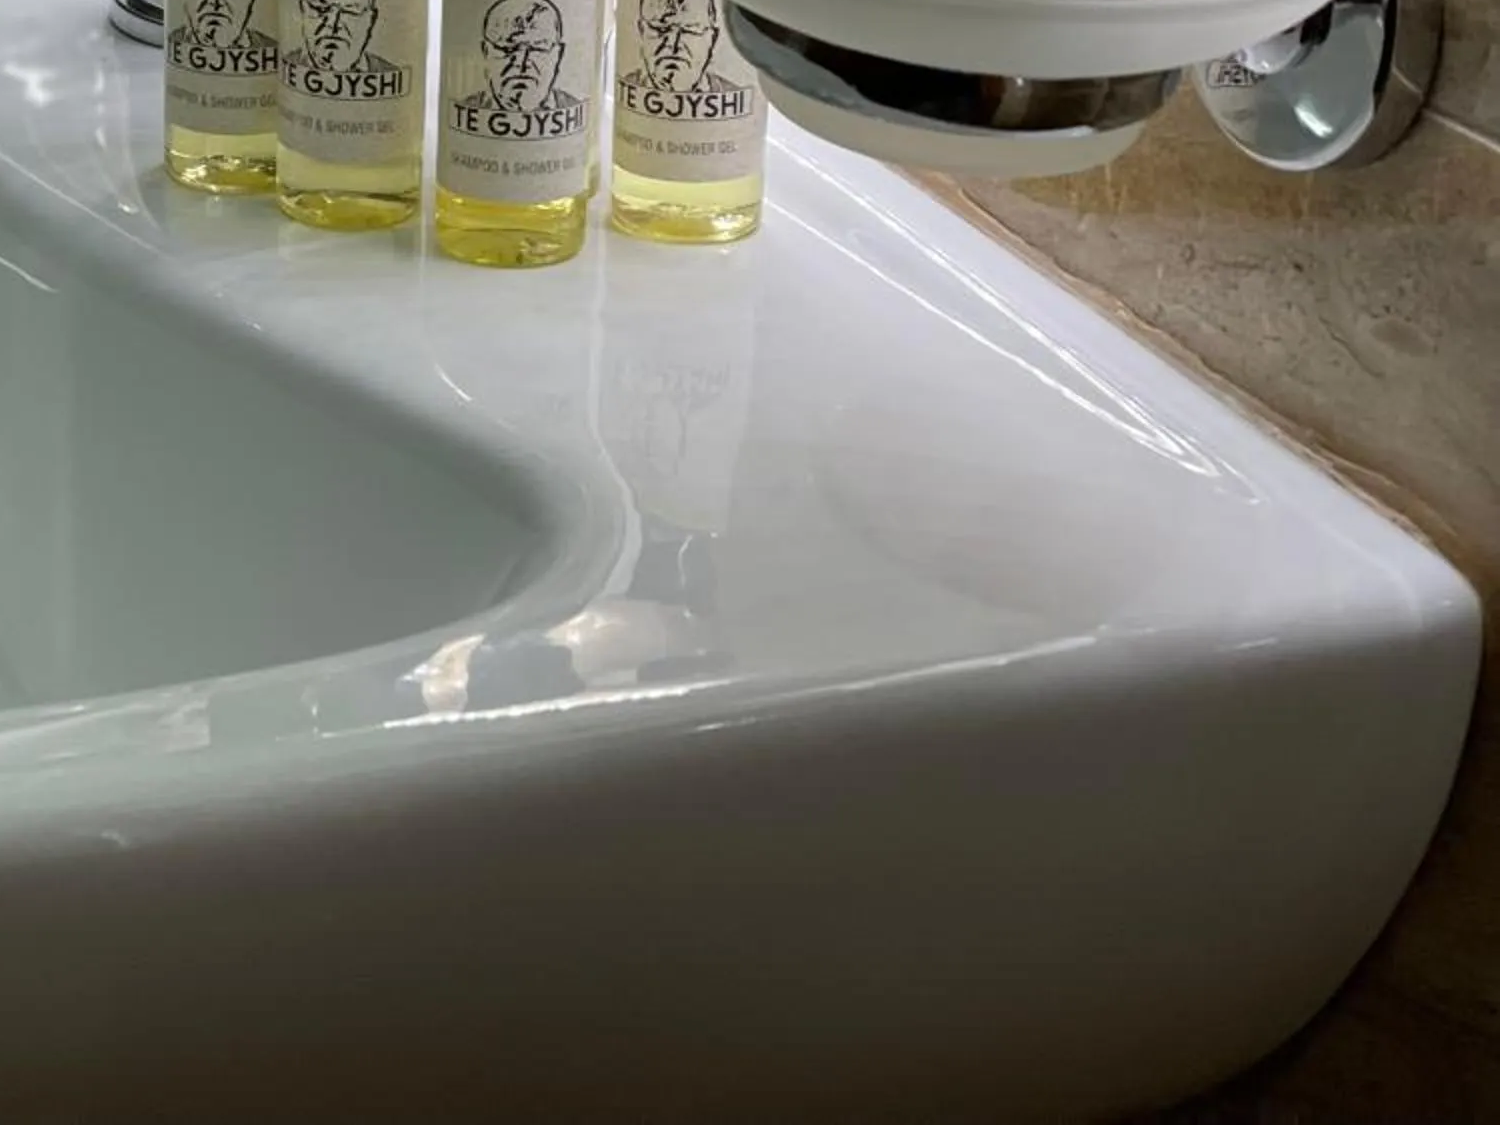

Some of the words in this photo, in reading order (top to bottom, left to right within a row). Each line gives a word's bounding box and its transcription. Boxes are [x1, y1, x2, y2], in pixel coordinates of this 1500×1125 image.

[189, 47, 278, 72] GJYSH
[303, 70, 403, 97] GJYSHI
[643, 90, 744, 118] GJYSHI
[454, 103, 479, 132] TE
[488, 104, 583, 137] GJYSHI
